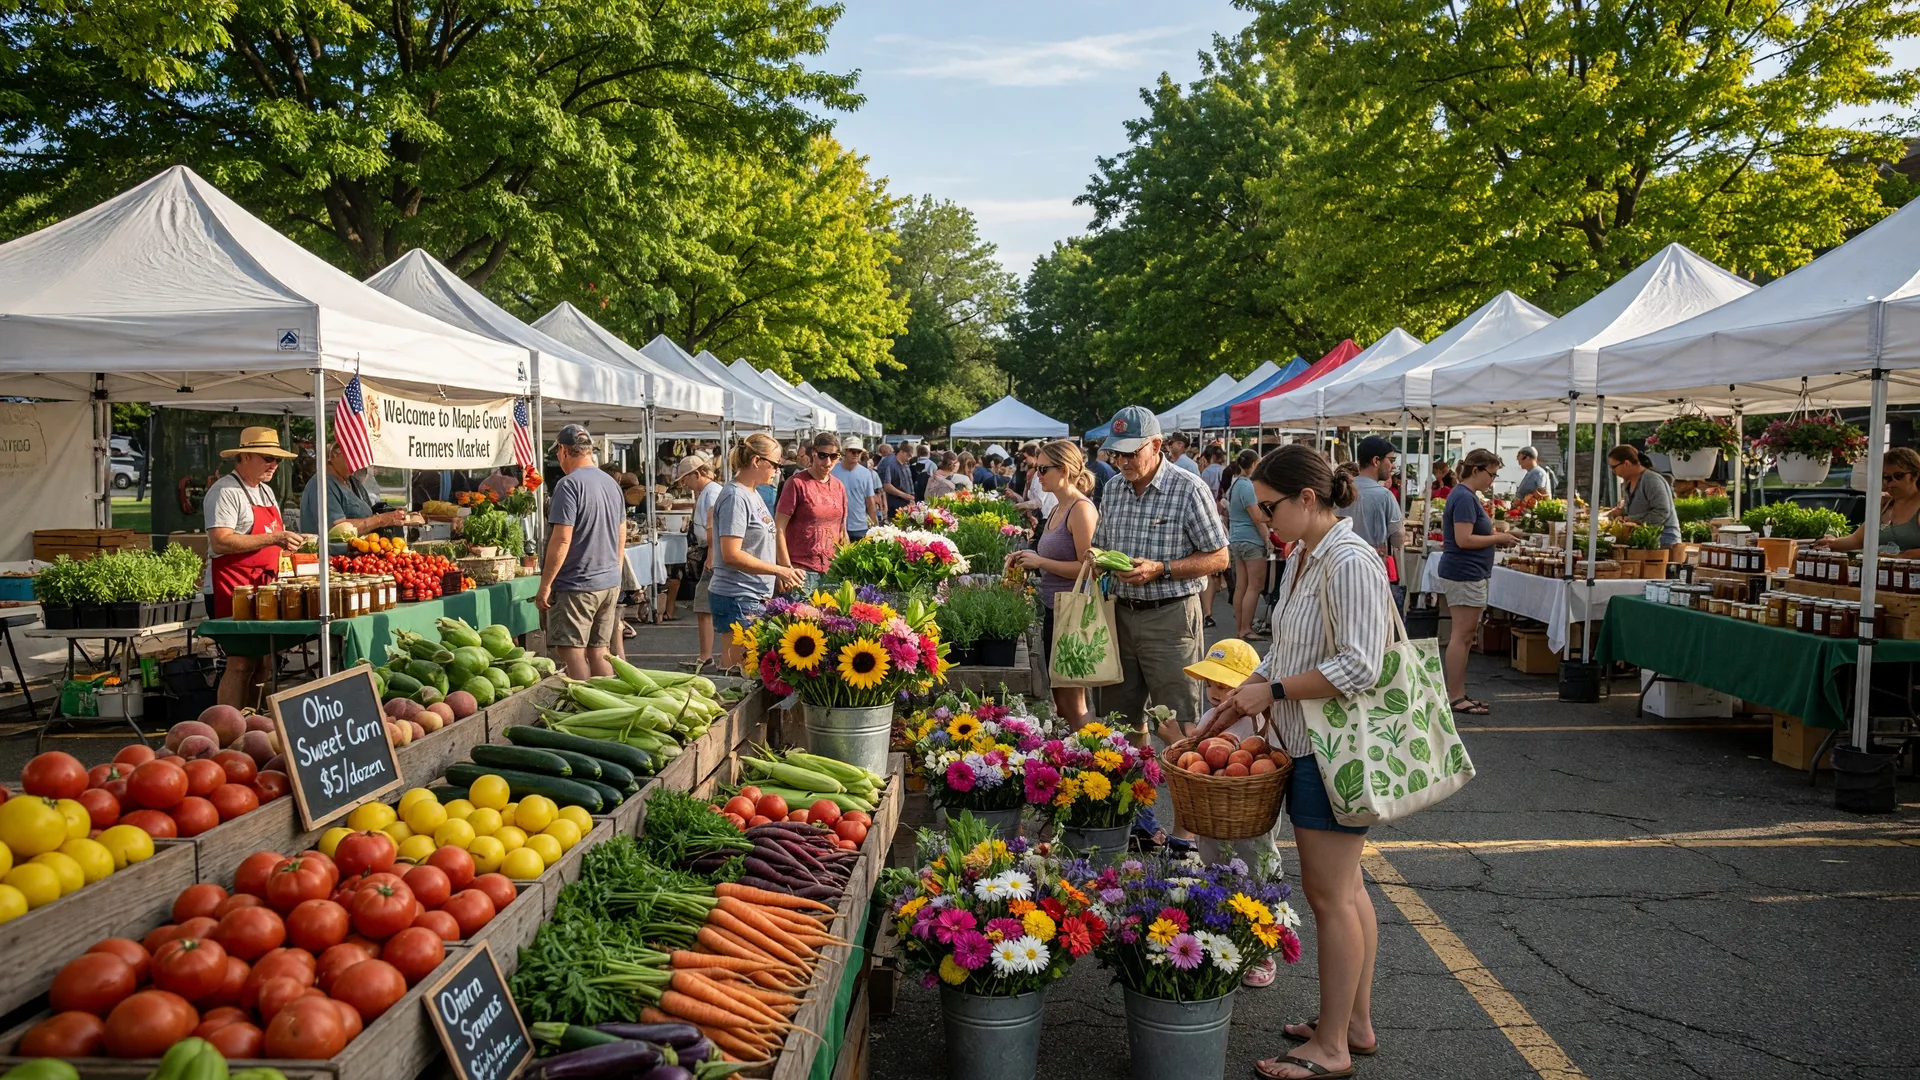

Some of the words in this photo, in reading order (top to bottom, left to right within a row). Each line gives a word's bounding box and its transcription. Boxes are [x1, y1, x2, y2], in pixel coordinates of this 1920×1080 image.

[384, 399, 435, 427] Welcome
[439, 409, 449, 427] to
[452, 407, 480, 433] Maple
[483, 410, 507, 429] Grove
[408, 436, 453, 457] Farmers
[457, 439, 490, 458] Market
[303, 696, 343, 728] Ohio
[297, 726, 345, 766] Sweet
[347, 718, 381, 745] Corn
[320, 758, 385, 798] $5/dozen
